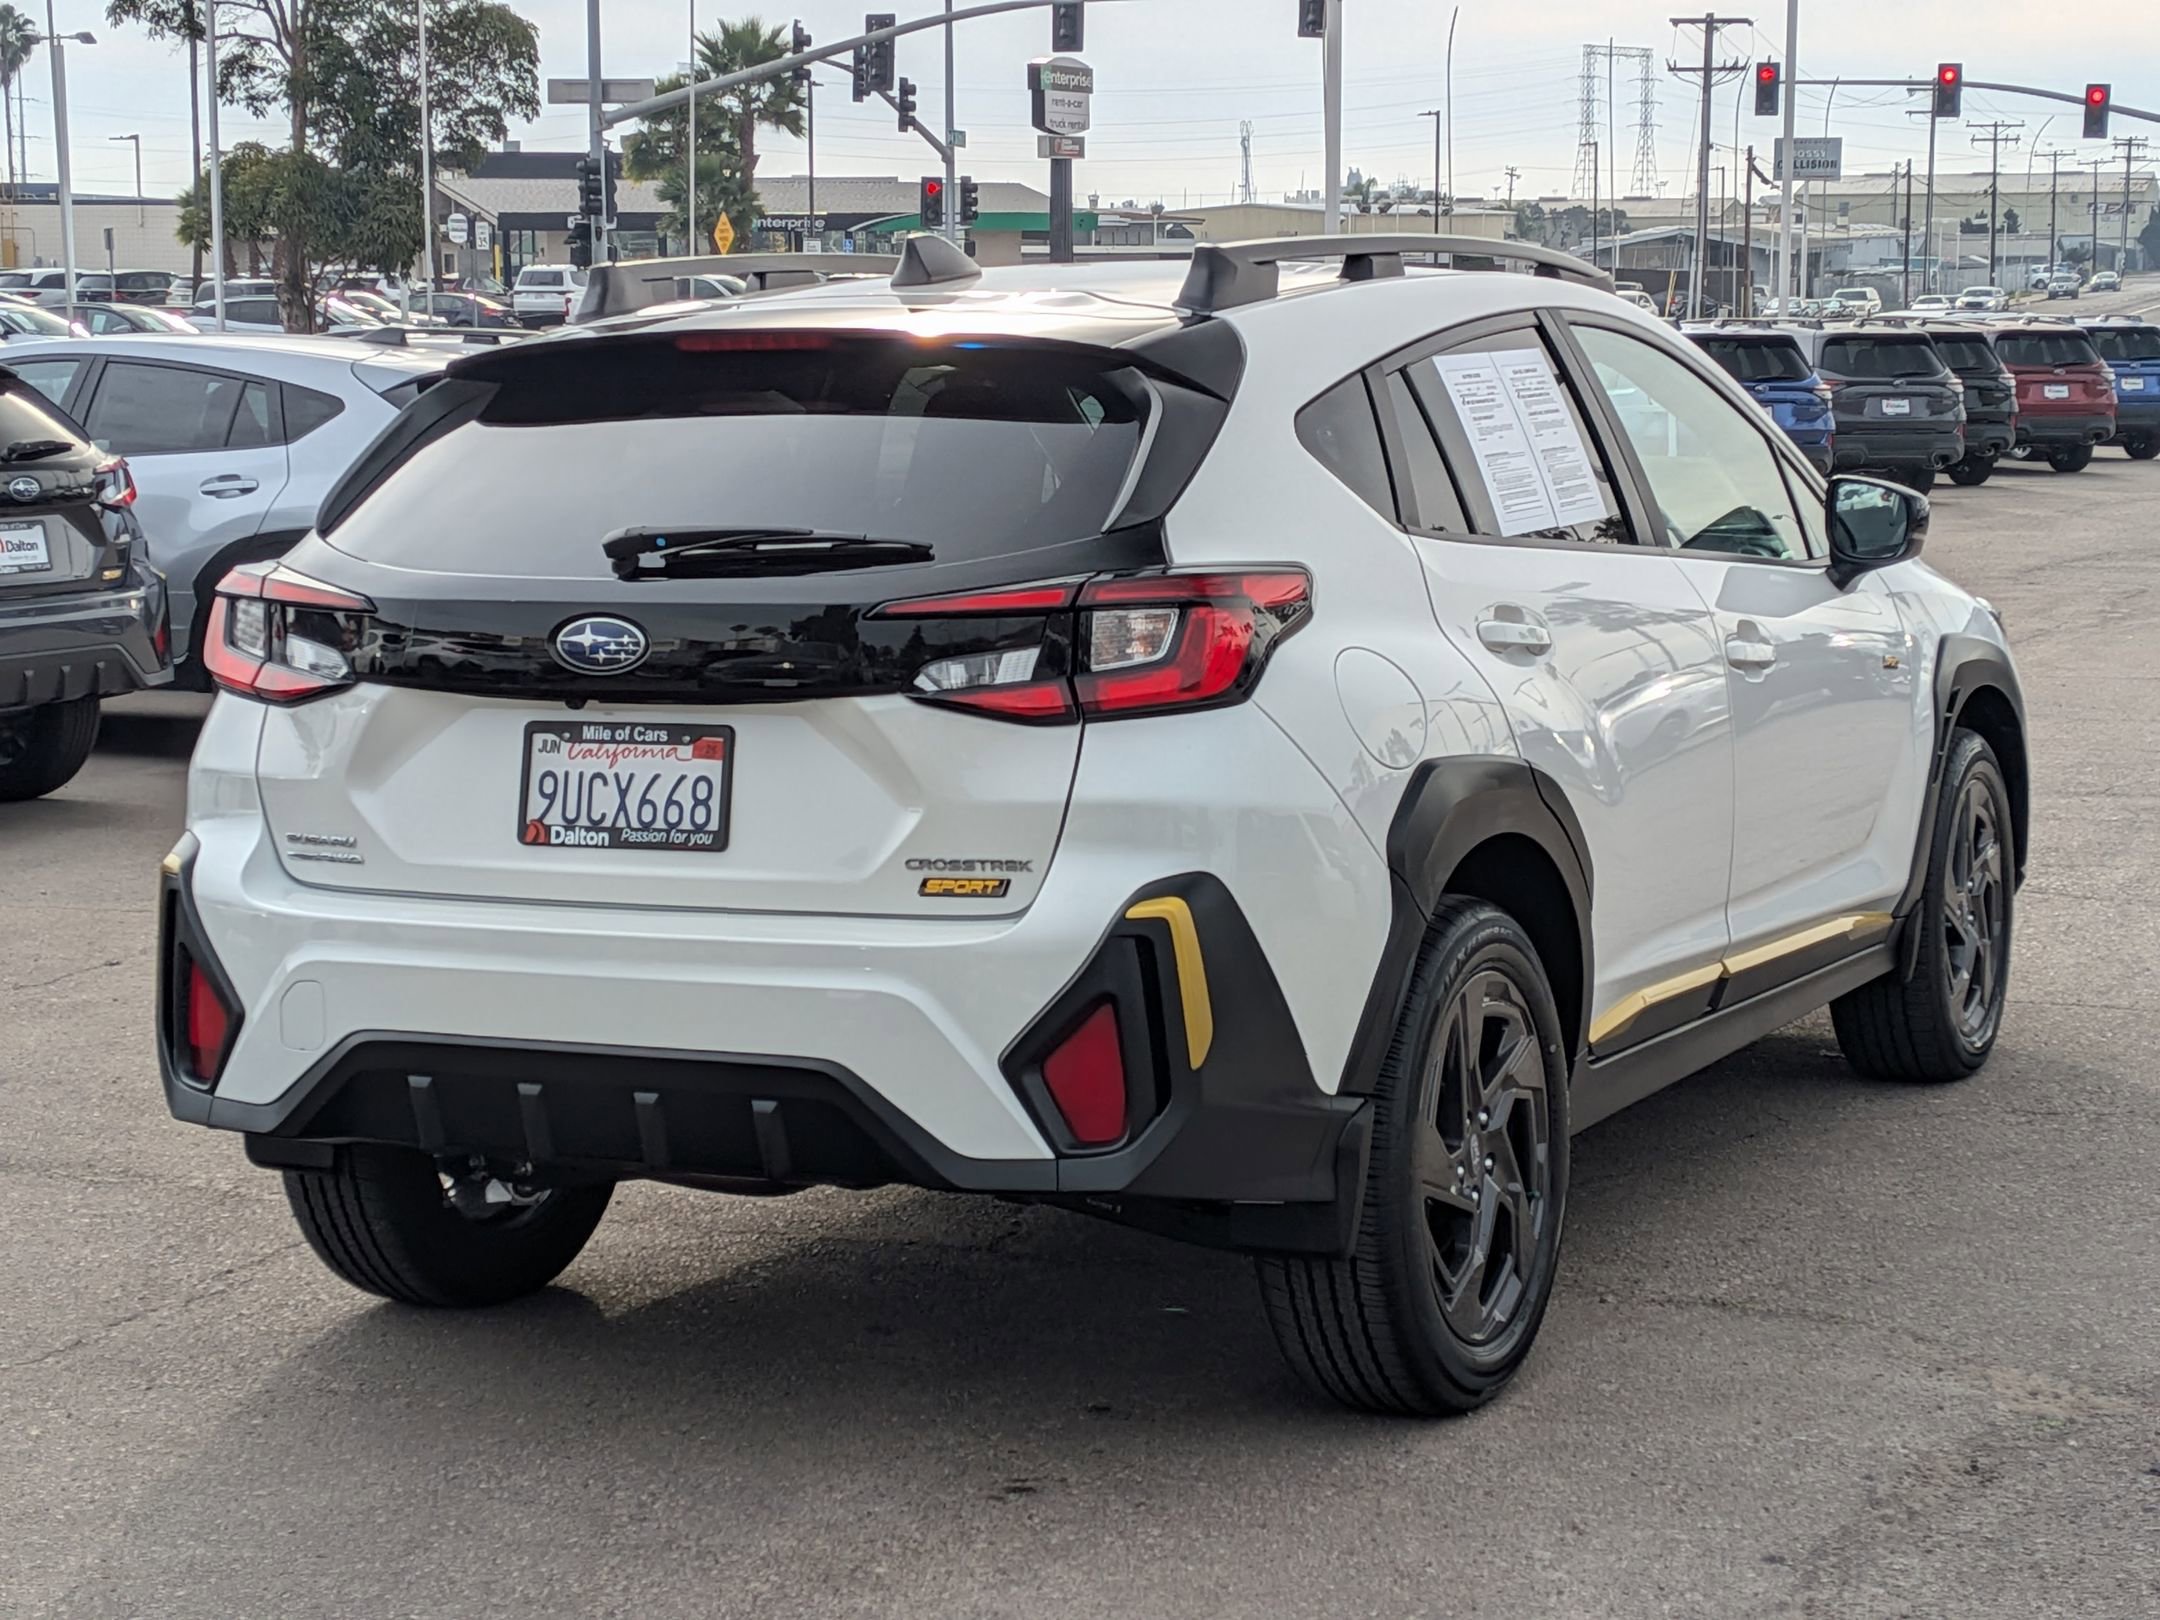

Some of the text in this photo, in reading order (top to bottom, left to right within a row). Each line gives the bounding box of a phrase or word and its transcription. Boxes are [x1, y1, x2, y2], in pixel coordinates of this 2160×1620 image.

[1044, 71, 1092, 89] enterprise
[1793, 149, 1826, 158] OSSY
[1777, 159, 1837, 169] CLLISION
[5, 539, 39, 552] Dalton
[582, 725, 668, 742] Mile of Cars
[538, 739, 692, 769] JUN California
[538, 770, 713, 830] 9UCX668
[550, 826, 609, 846] Dalton
[620, 828, 714, 847] Passion for you
[905, 858, 1034, 872] CROSSTREK
[923, 879, 1000, 894] SPORT
